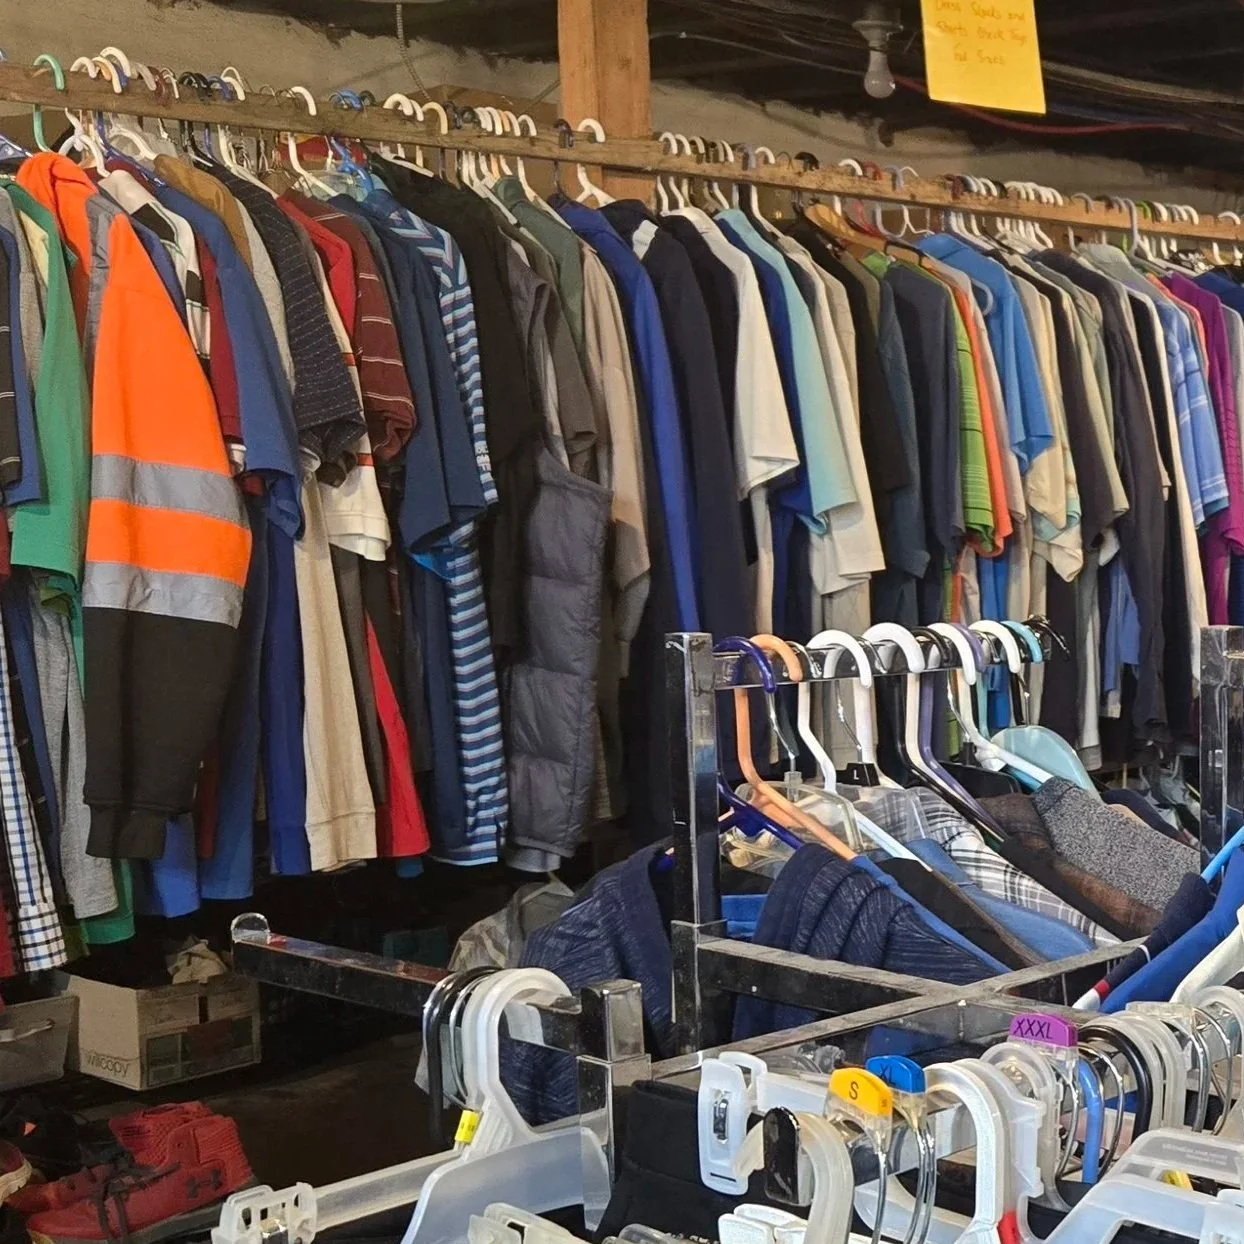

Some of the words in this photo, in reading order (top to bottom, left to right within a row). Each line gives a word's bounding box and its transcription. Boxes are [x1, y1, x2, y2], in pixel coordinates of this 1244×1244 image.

[853, 769, 860, 780] L
[1013, 1018, 1053, 1039] XXXL
[880, 1063, 897, 1086] XL
[849, 1081, 859, 1100] S
